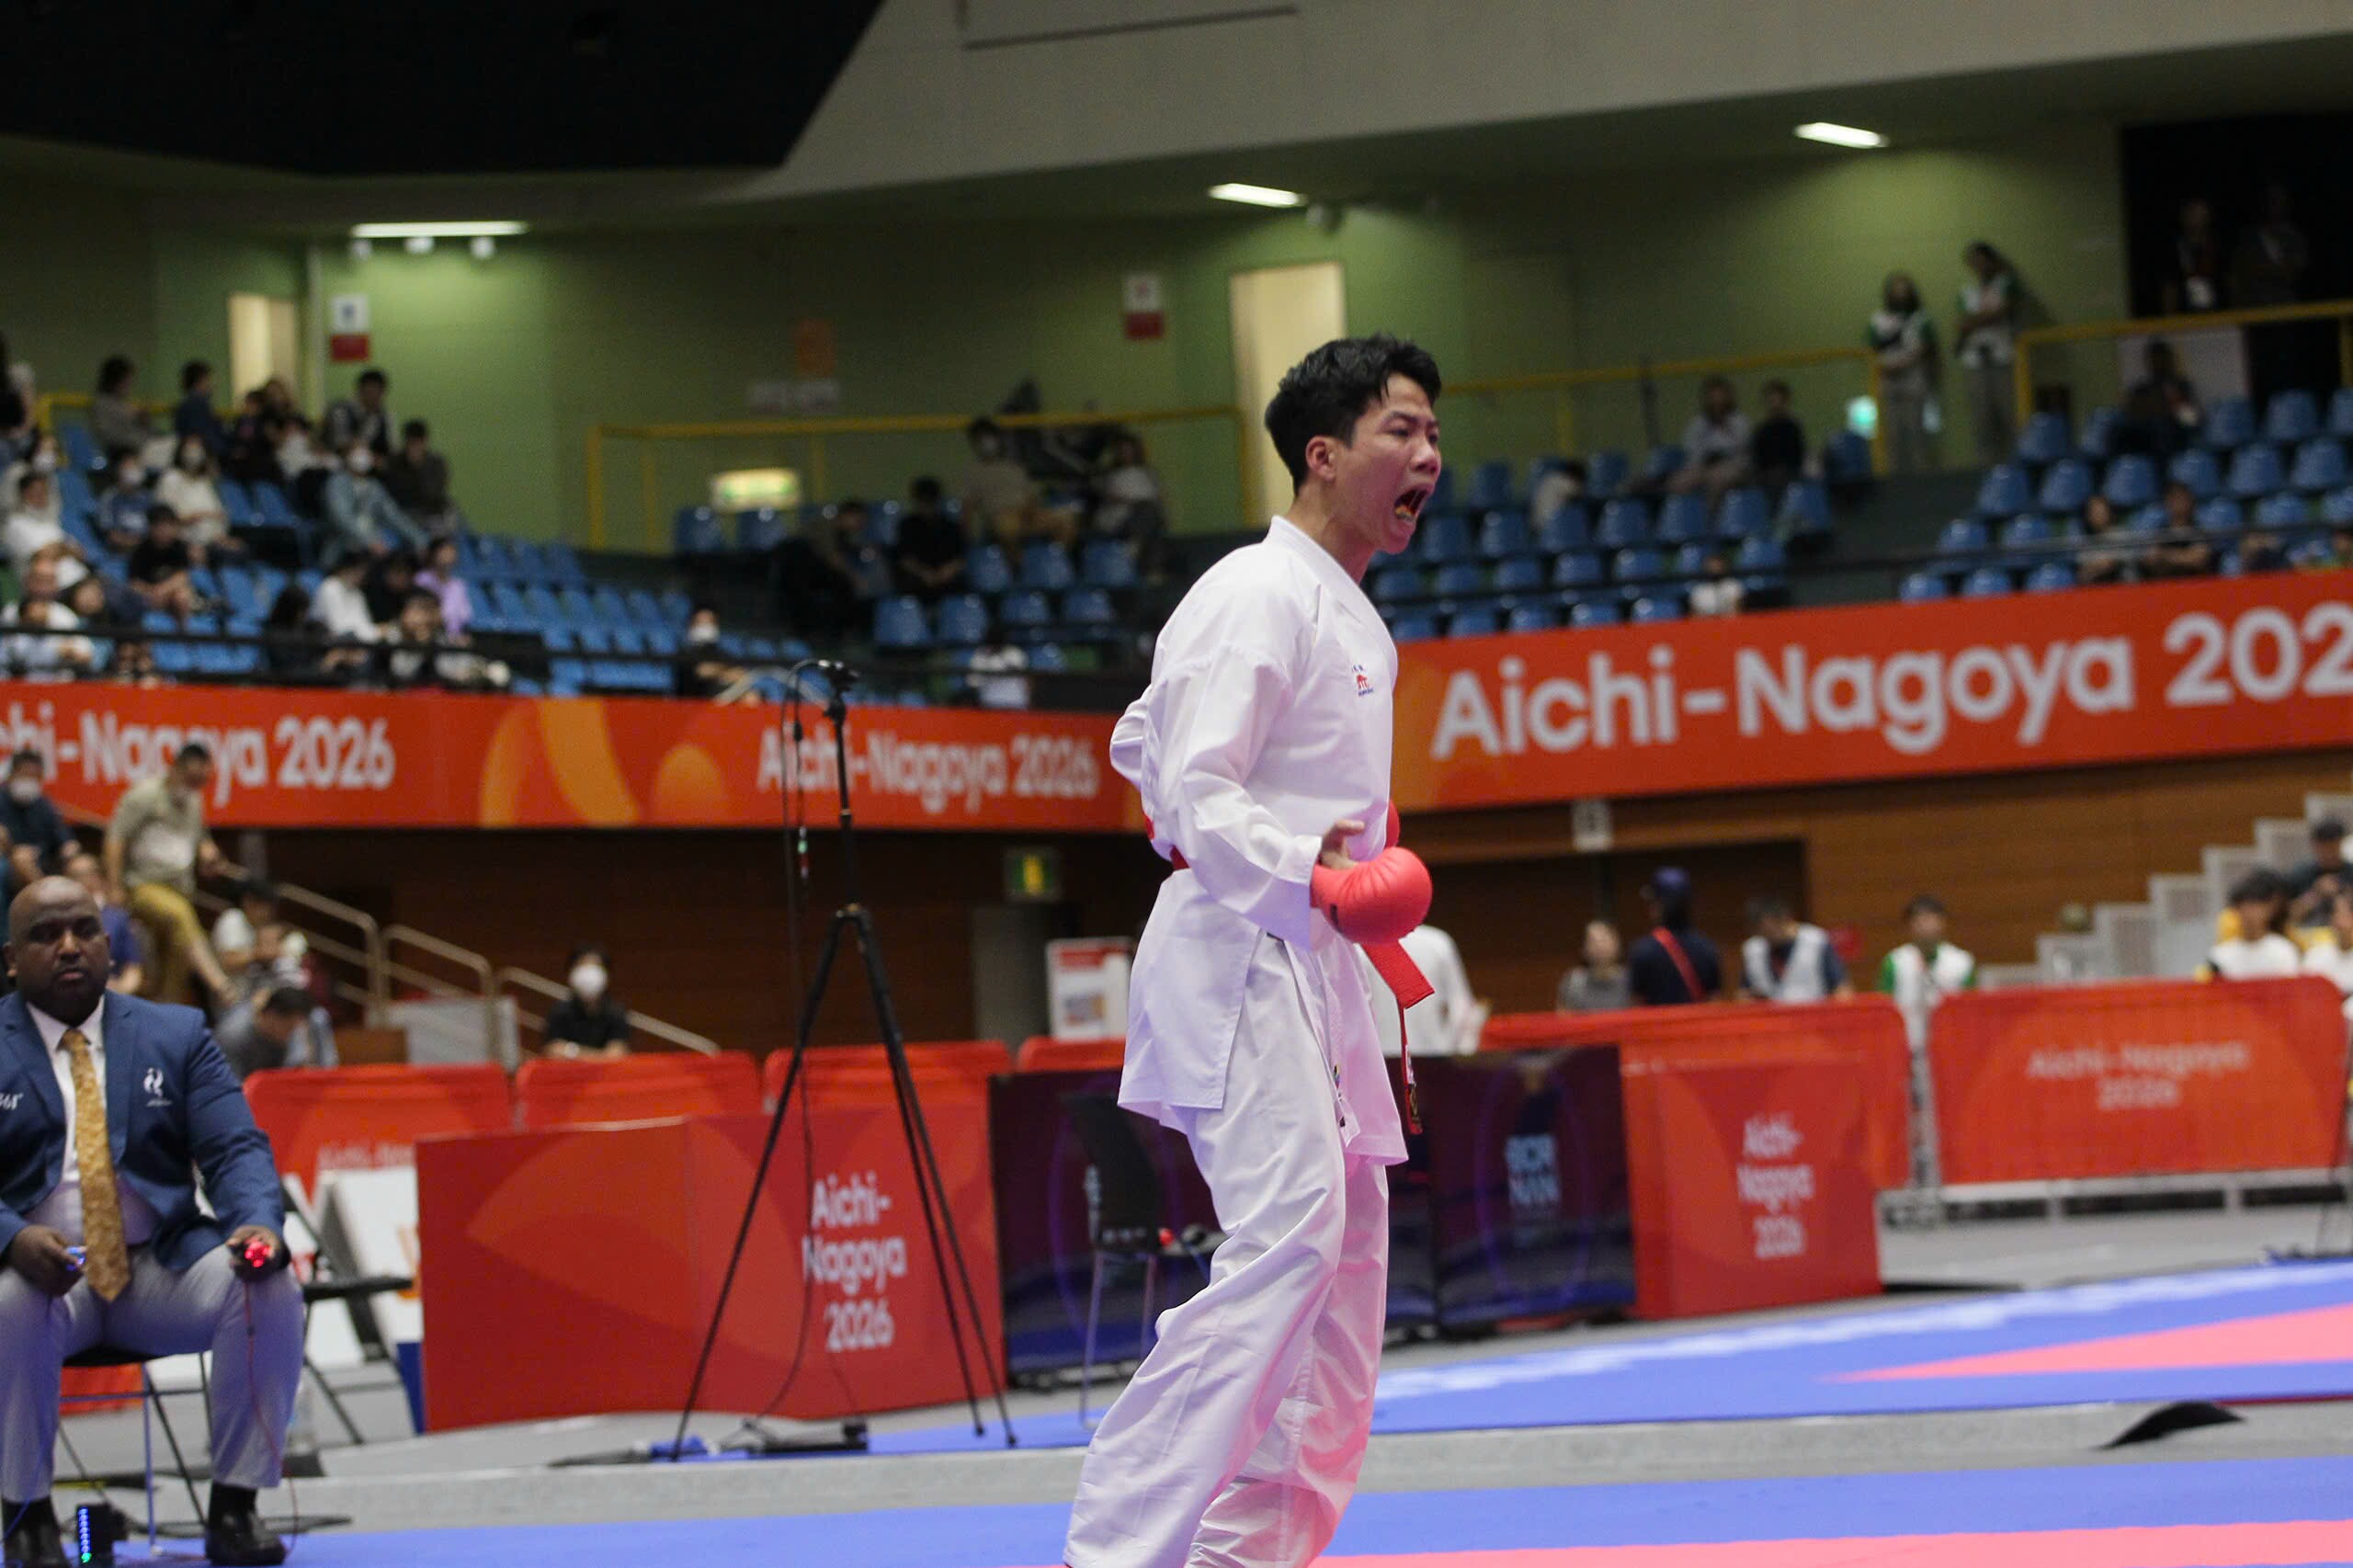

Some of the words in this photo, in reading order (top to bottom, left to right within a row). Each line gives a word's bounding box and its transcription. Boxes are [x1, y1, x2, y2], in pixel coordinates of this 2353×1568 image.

[1430, 631, 2134, 757] Aichi-Nagoya
[0, 701, 268, 807] hi-Naya
[275, 715, 395, 790] 2026
[757, 722, 1008, 814] Aichi-Nagoya
[1012, 733, 1099, 799] 2026
[811, 1171, 892, 1229] Aichi-
[801, 1236, 908, 1296] Nagoya
[824, 1297, 896, 1352] 2026
